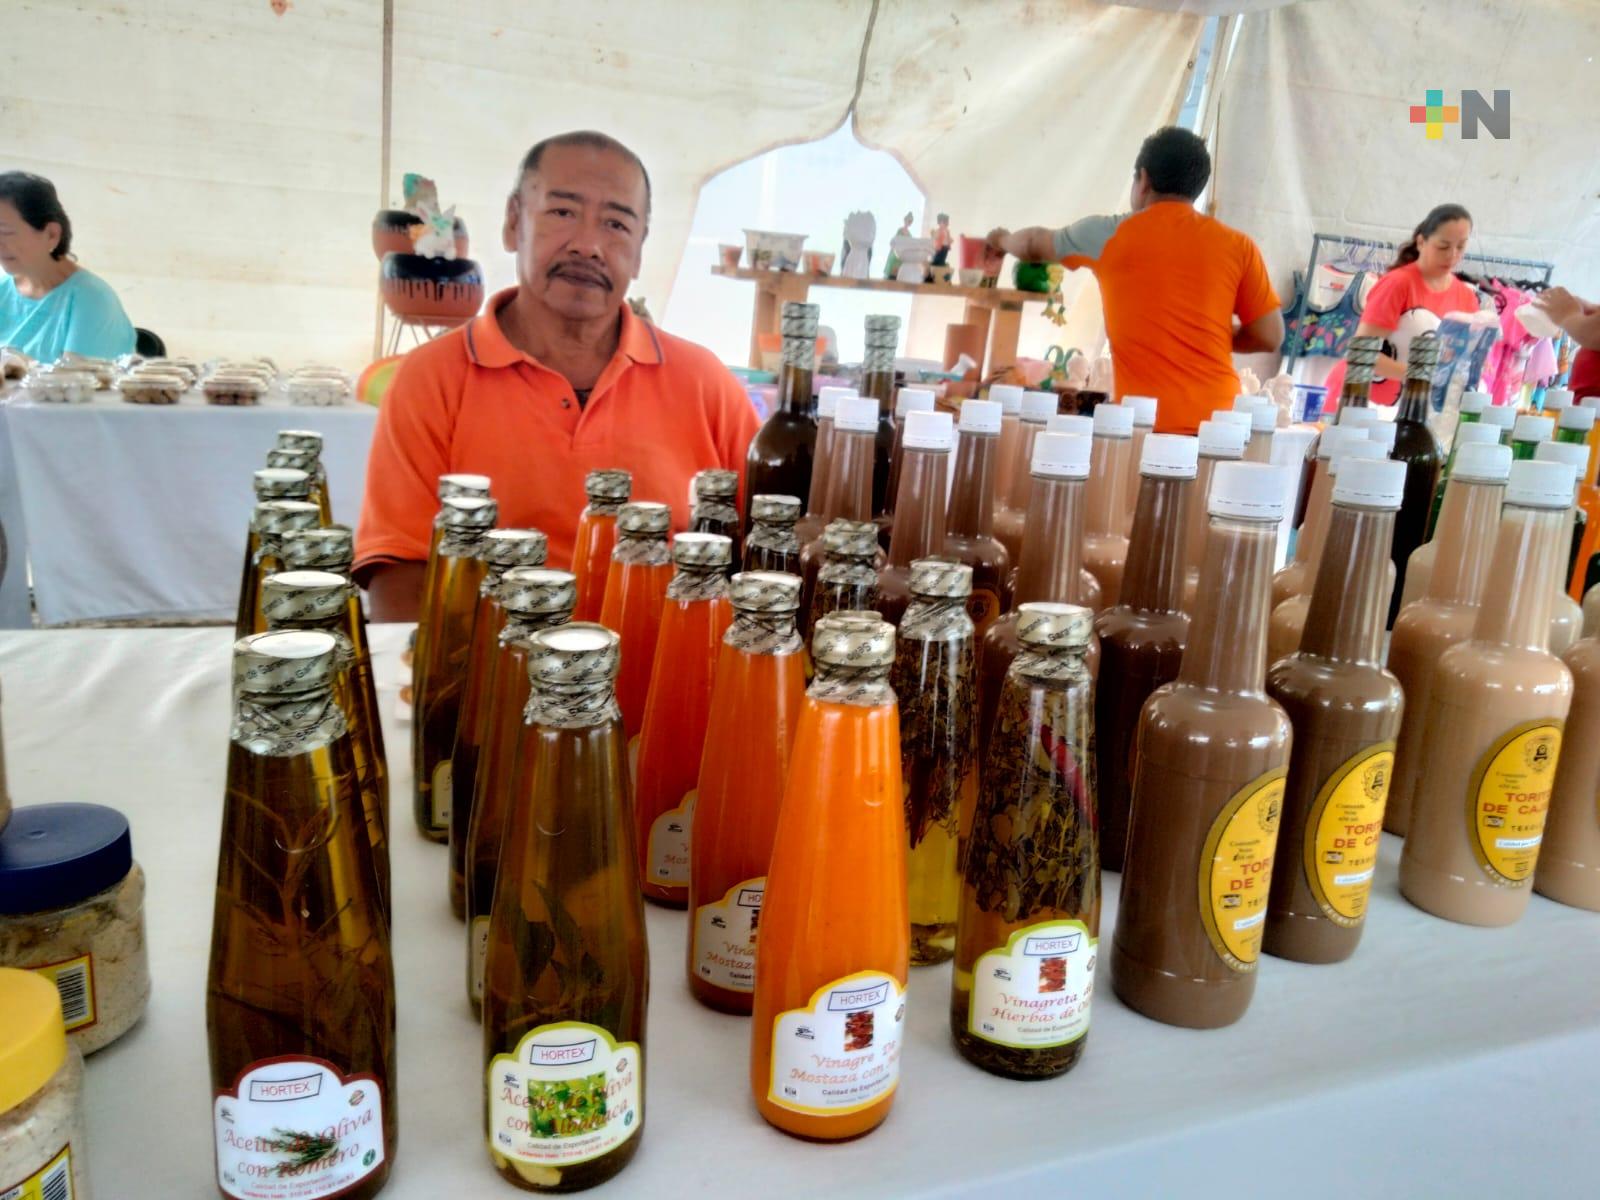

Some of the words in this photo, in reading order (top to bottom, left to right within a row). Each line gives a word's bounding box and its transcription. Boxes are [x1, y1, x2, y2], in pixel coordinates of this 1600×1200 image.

[1483, 803, 1508, 814] DE
[1344, 821, 1381, 835] TORIT
[1333, 839, 1357, 848] DE
[1364, 835, 1379, 846] CA
[1240, 859, 1270, 875] TOR
[1230, 878, 1254, 891] DE
[748, 894, 762, 903] HO
[723, 942, 755, 955] Vina
[1035, 940, 1073, 951] HORTEX
[705, 952, 756, 969] Mostaz
[840, 992, 881, 1006] HORTEX
[1000, 992, 1077, 1011] Vinagreta
[991, 1006, 1055, 1023] Hierbas
[1059, 1006, 1074, 1020] de
[541, 1047, 586, 1060] HORTEX
[811, 1052, 875, 1070] Vinagre
[790, 1067, 857, 1086] Mostaza
[261, 1081, 310, 1096] HORTEX
[821, 1088, 849, 1096] Calidad
[224, 1128, 280, 1153] Aceite
[320, 1108, 374, 1143] Oliva
[237, 1161, 269, 1178] con
[277, 1143, 360, 1178] Romero
